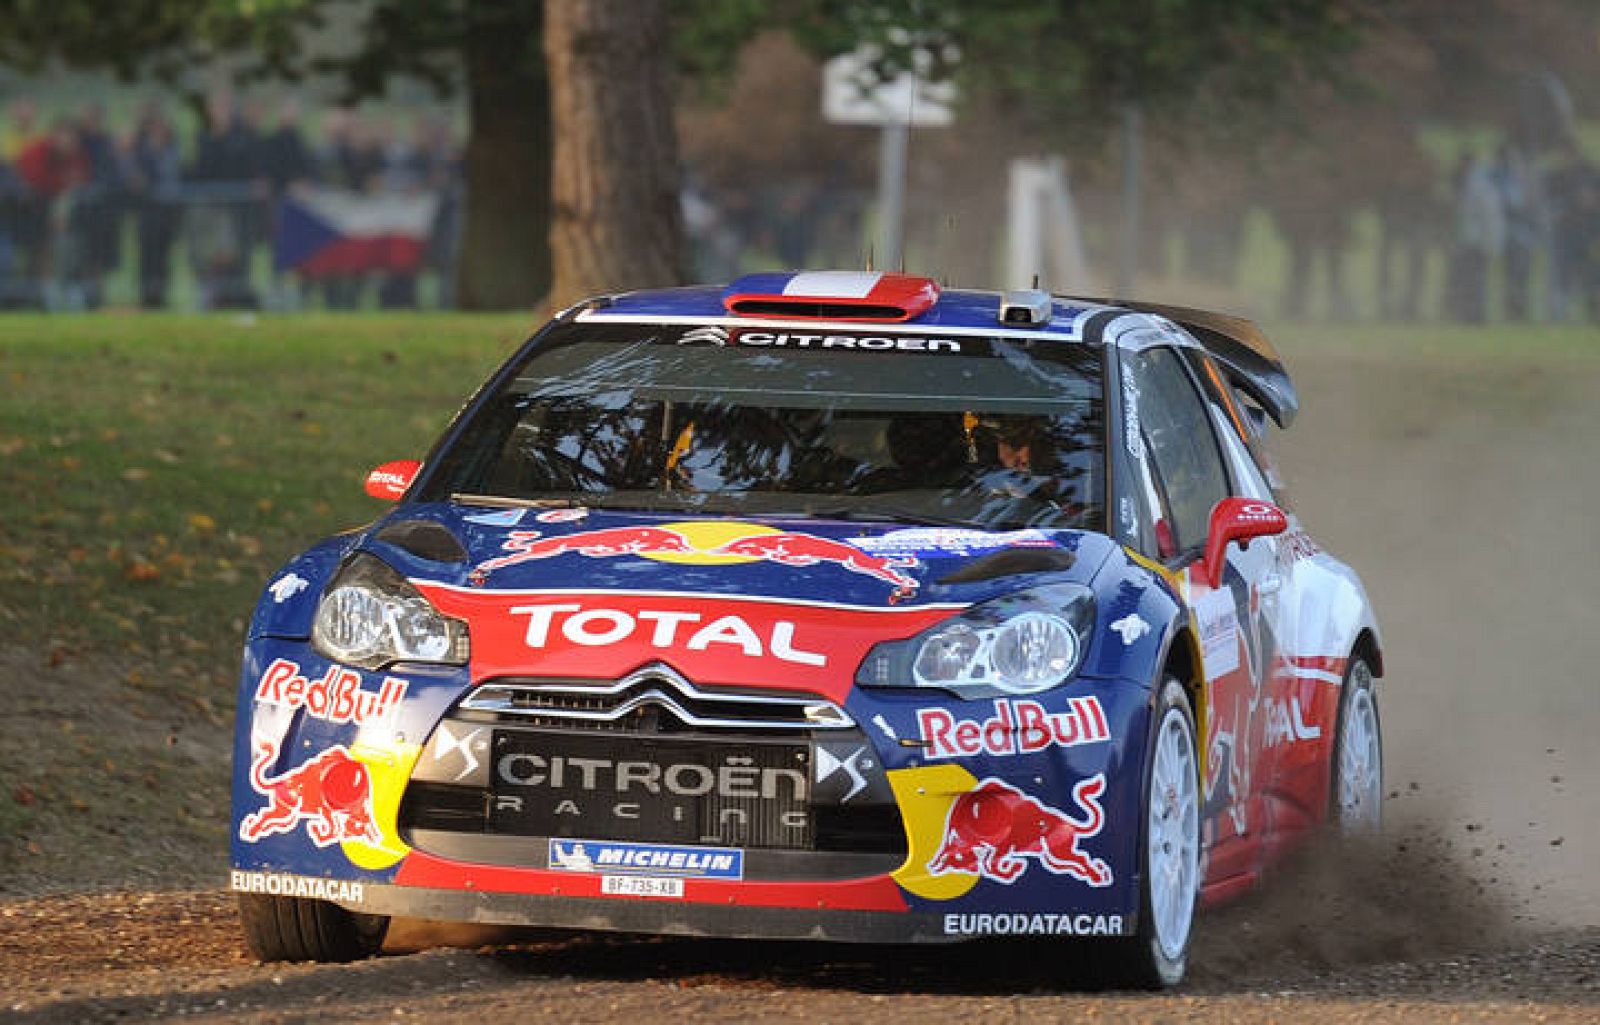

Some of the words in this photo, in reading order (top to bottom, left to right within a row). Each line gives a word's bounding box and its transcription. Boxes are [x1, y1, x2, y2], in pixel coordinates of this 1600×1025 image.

[509, 604, 827, 667] TOTAL
[256, 658, 338, 718] Red
[331, 669, 409, 723] Bull
[917, 699, 1015, 758] Red
[1014, 696, 1111, 753] Bull
[597, 848, 734, 870] MICHELIN
[231, 870, 363, 902] EURODATACAR
[943, 913, 1123, 935] EURODATACAR
